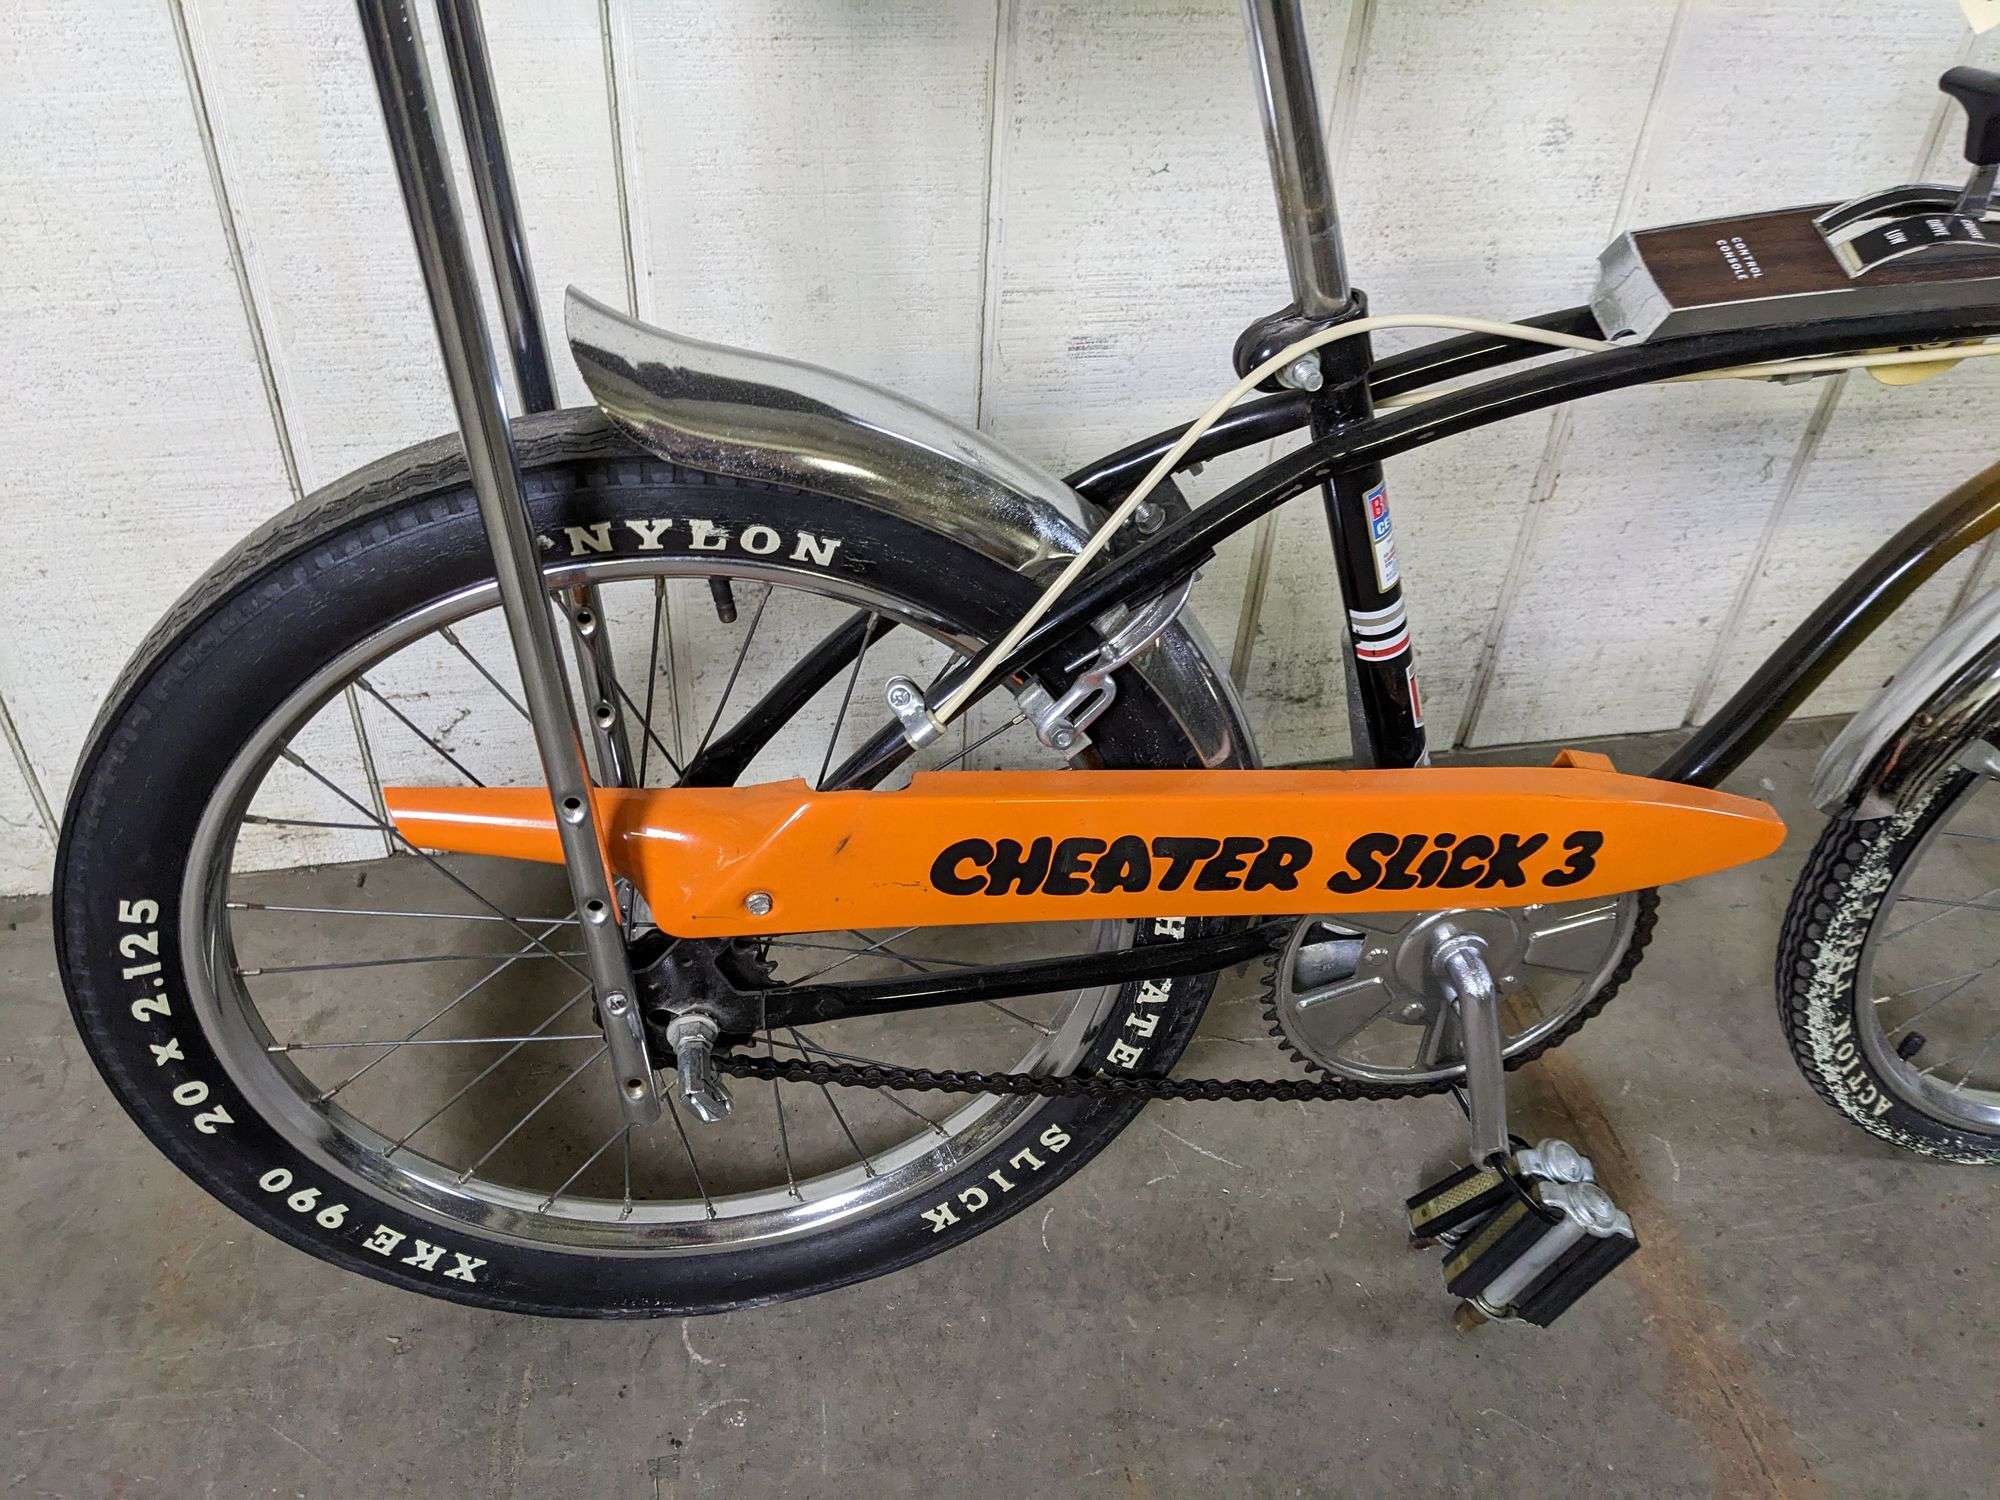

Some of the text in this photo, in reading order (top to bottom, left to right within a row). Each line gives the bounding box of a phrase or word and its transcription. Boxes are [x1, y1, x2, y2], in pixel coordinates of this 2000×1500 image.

[1715, 239, 1749, 281] CONSOLE
[1730, 236, 1764, 279] CONTROL
[564, 517, 842, 567] NYLON
[929, 836, 1313, 896] CHEATER
[1542, 830, 1604, 887] 3
[118, 898, 173, 1023] 2.125
[1832, 1014, 1894, 1117] ACTION
[172, 1079, 236, 1135] 20
[919, 1122, 1072, 1235] SLICK
[362, 1222, 489, 1284] XKE
